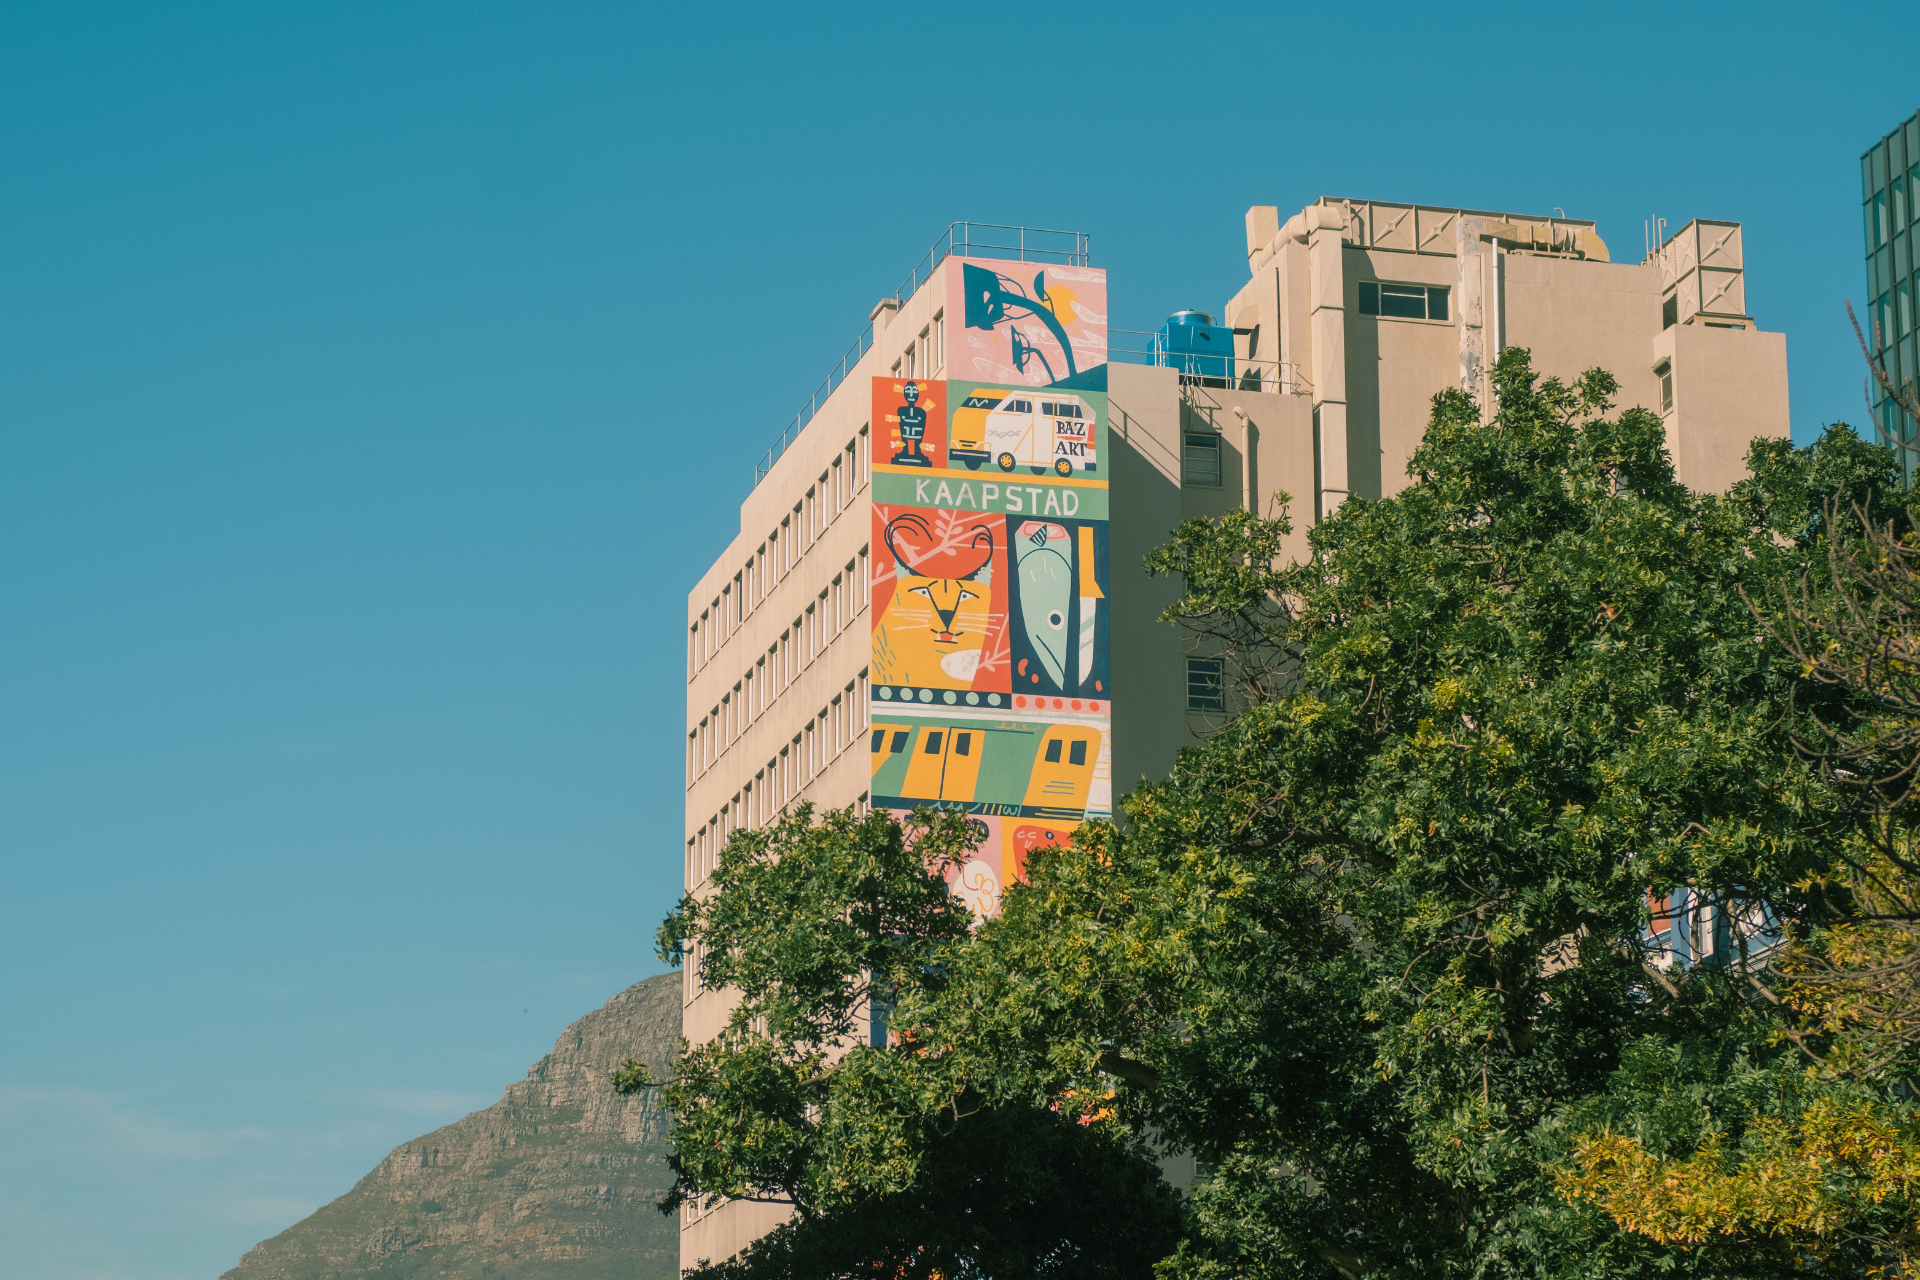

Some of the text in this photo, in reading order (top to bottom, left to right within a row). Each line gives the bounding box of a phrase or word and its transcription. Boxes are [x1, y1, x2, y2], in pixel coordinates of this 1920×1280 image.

[1056, 421, 1086, 436] BAZ
[1055, 441, 1087, 456] ART
[915, 479, 1079, 516] KAAPSTAD
